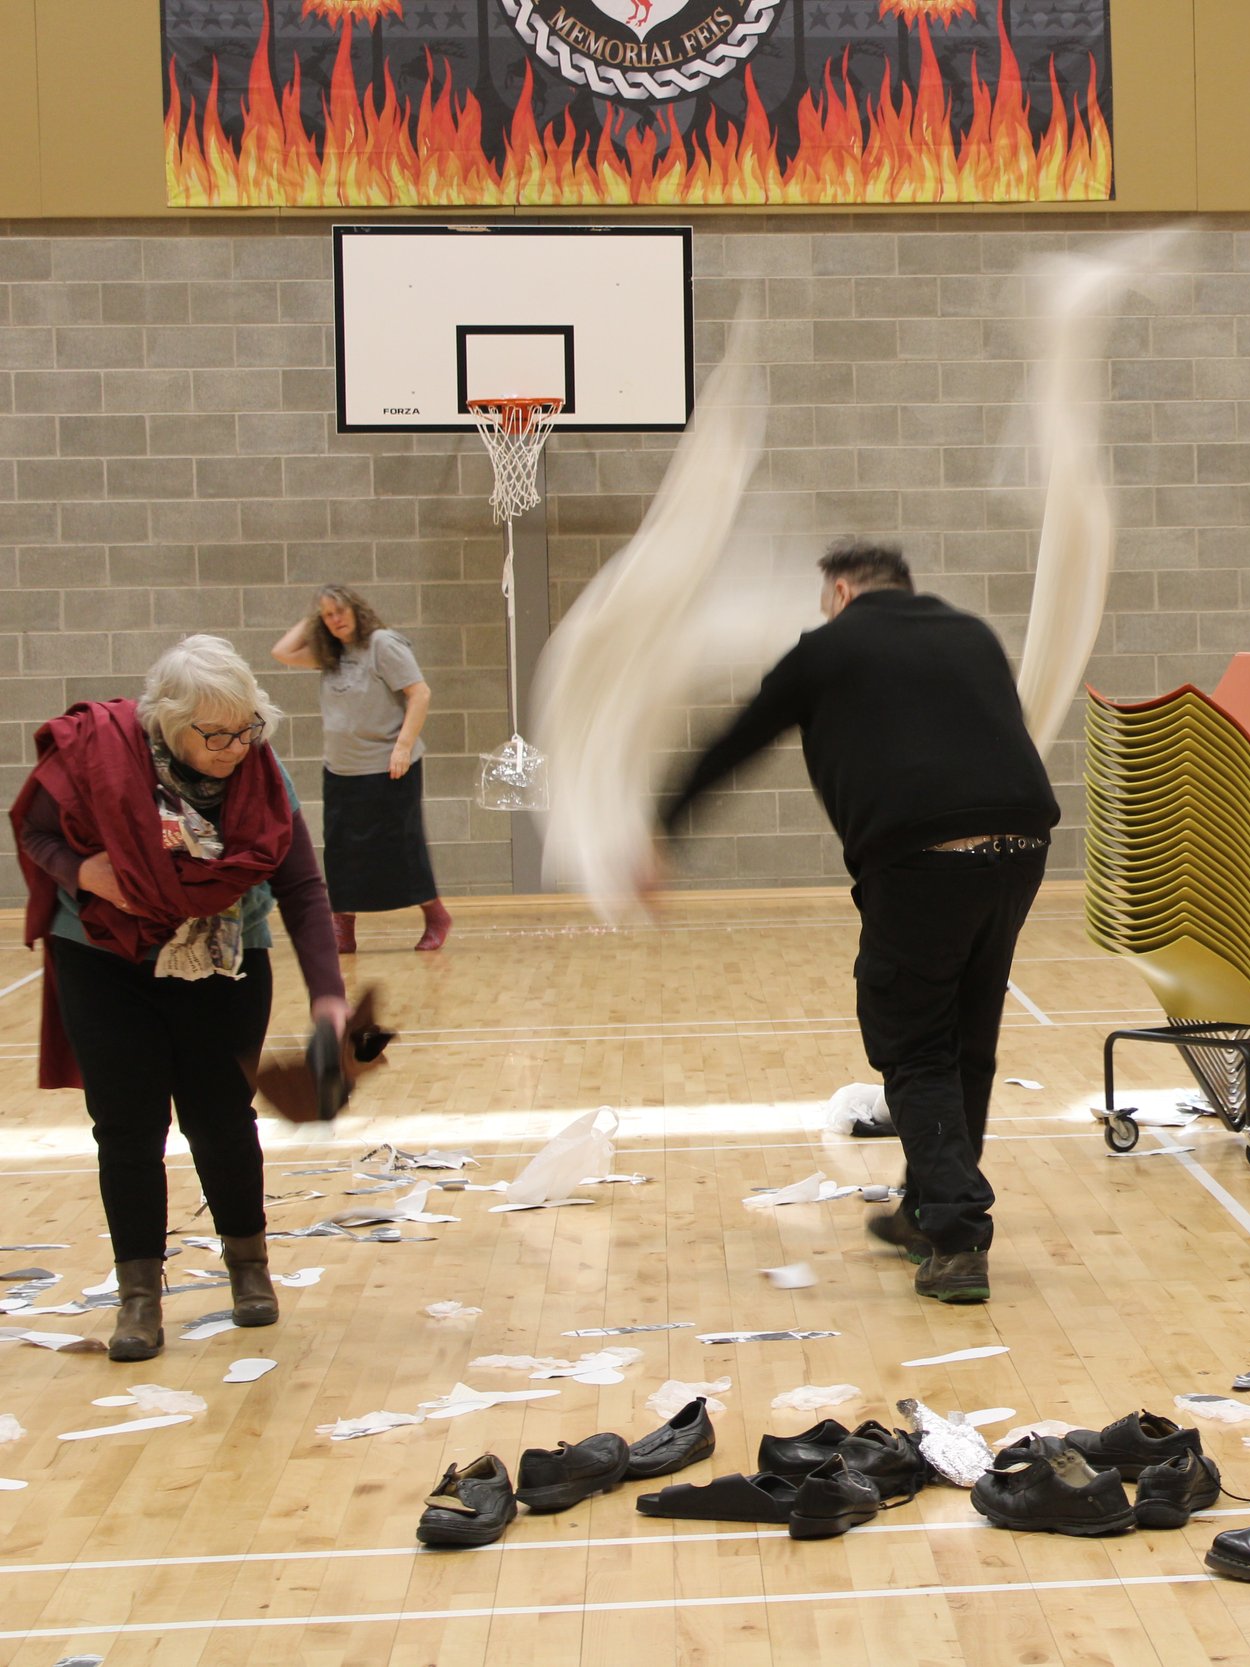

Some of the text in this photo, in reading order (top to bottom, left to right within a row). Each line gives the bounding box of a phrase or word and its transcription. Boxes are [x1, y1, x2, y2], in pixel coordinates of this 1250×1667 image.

[547, 6, 733, 67] MEMORIAL FEIS
[383, 407, 420, 415] FORZA
